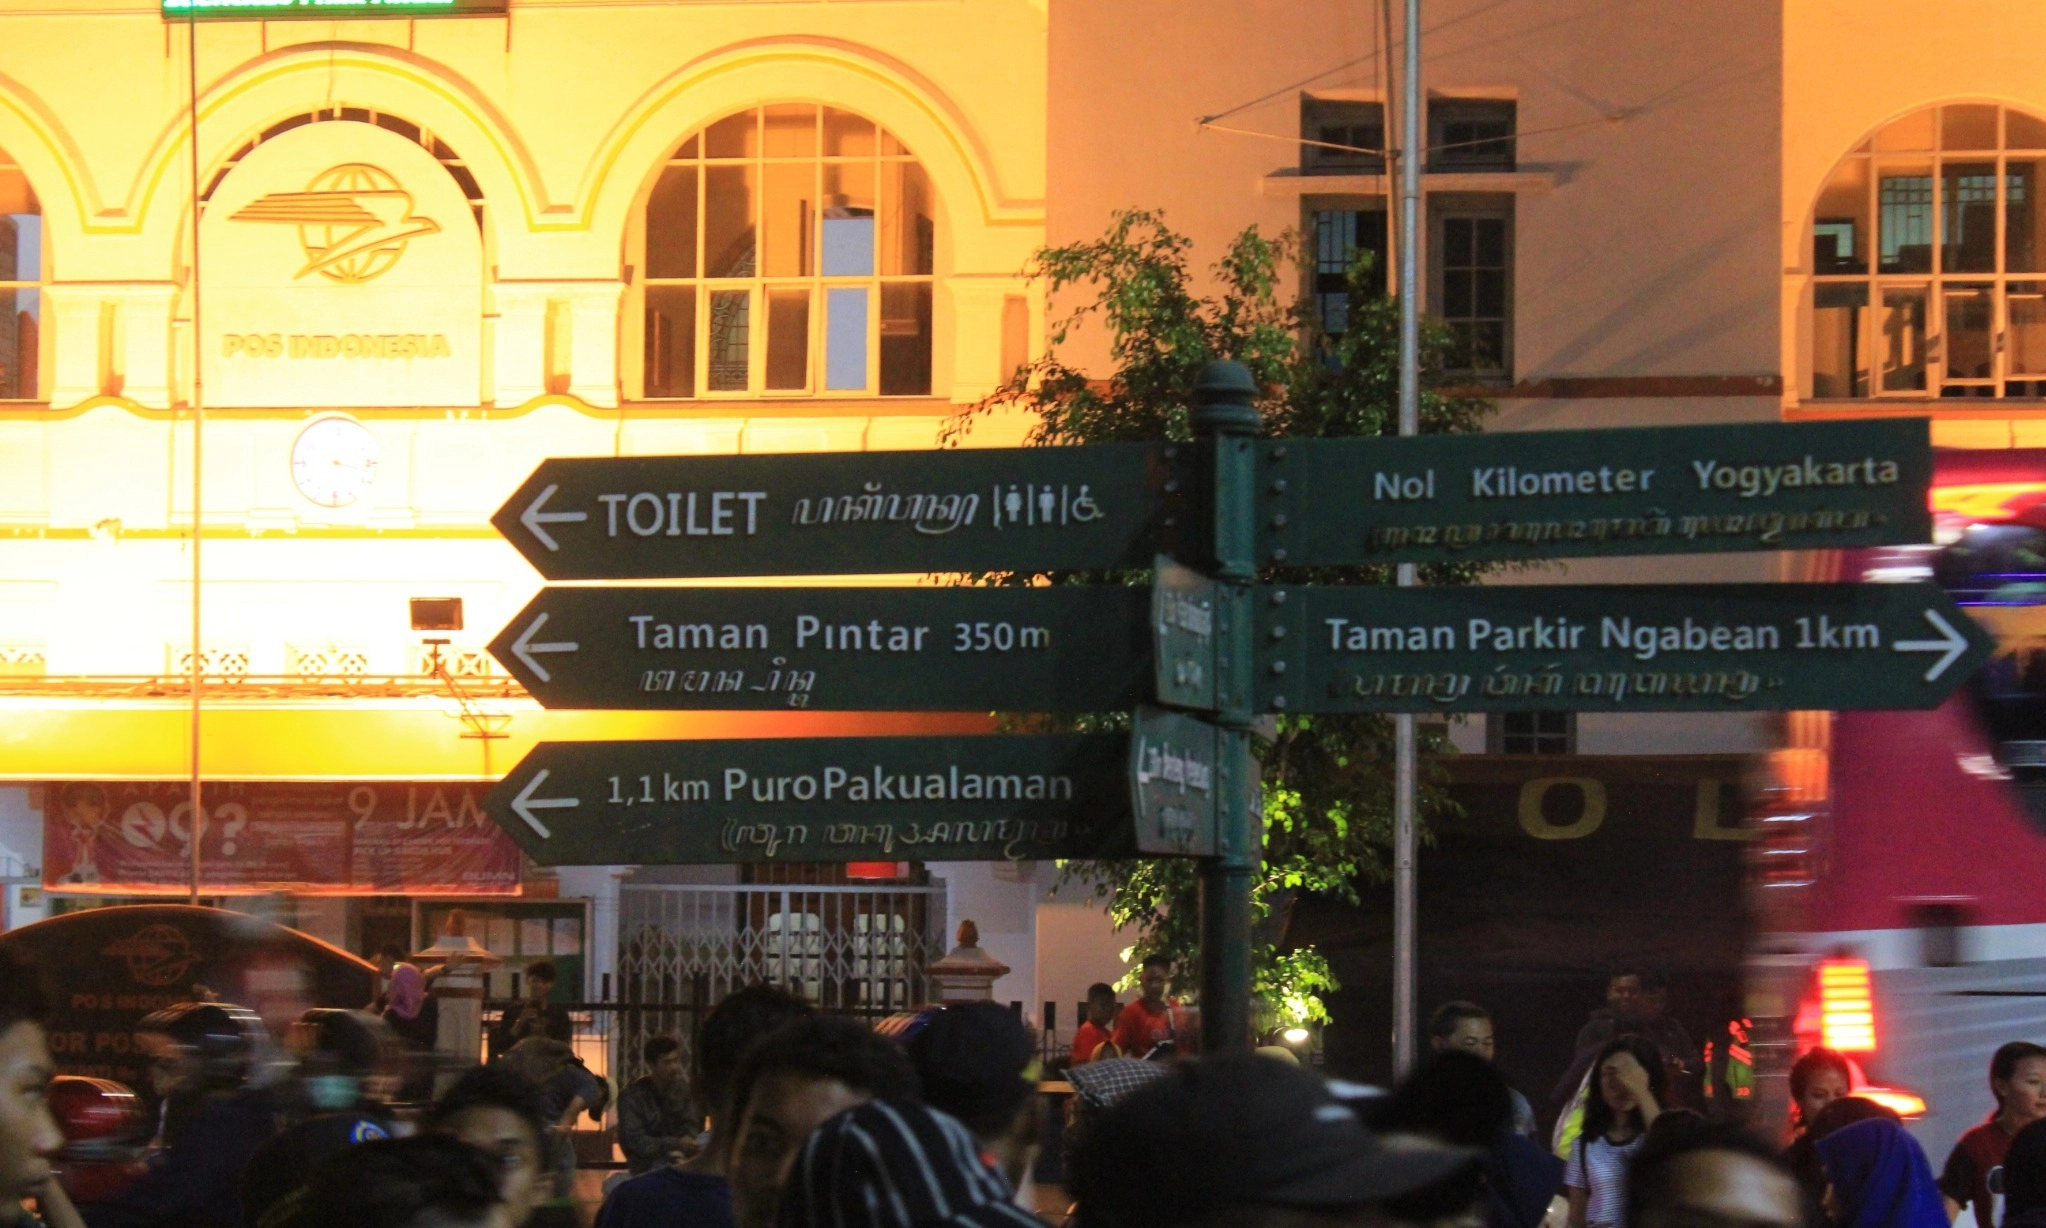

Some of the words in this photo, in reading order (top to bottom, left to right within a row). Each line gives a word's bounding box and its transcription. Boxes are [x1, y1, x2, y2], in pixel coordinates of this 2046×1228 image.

[222, 333, 283, 358] POS
[288, 333, 451, 359] INDONESIA
[1374, 469, 1434, 500] Nol
[1473, 466, 1655, 496] Kilometer
[1693, 456, 1898, 498] Yogyakarta
[597, 491, 767, 537] TOILET
[628, 615, 768, 650] Taman
[796, 614, 929, 651] Pintar
[1325, 618, 1456, 651] Taman
[1468, 617, 1585, 651] Parkir
[1601, 616, 1779, 660] Ngabean
[349, 785, 378, 830] 9
